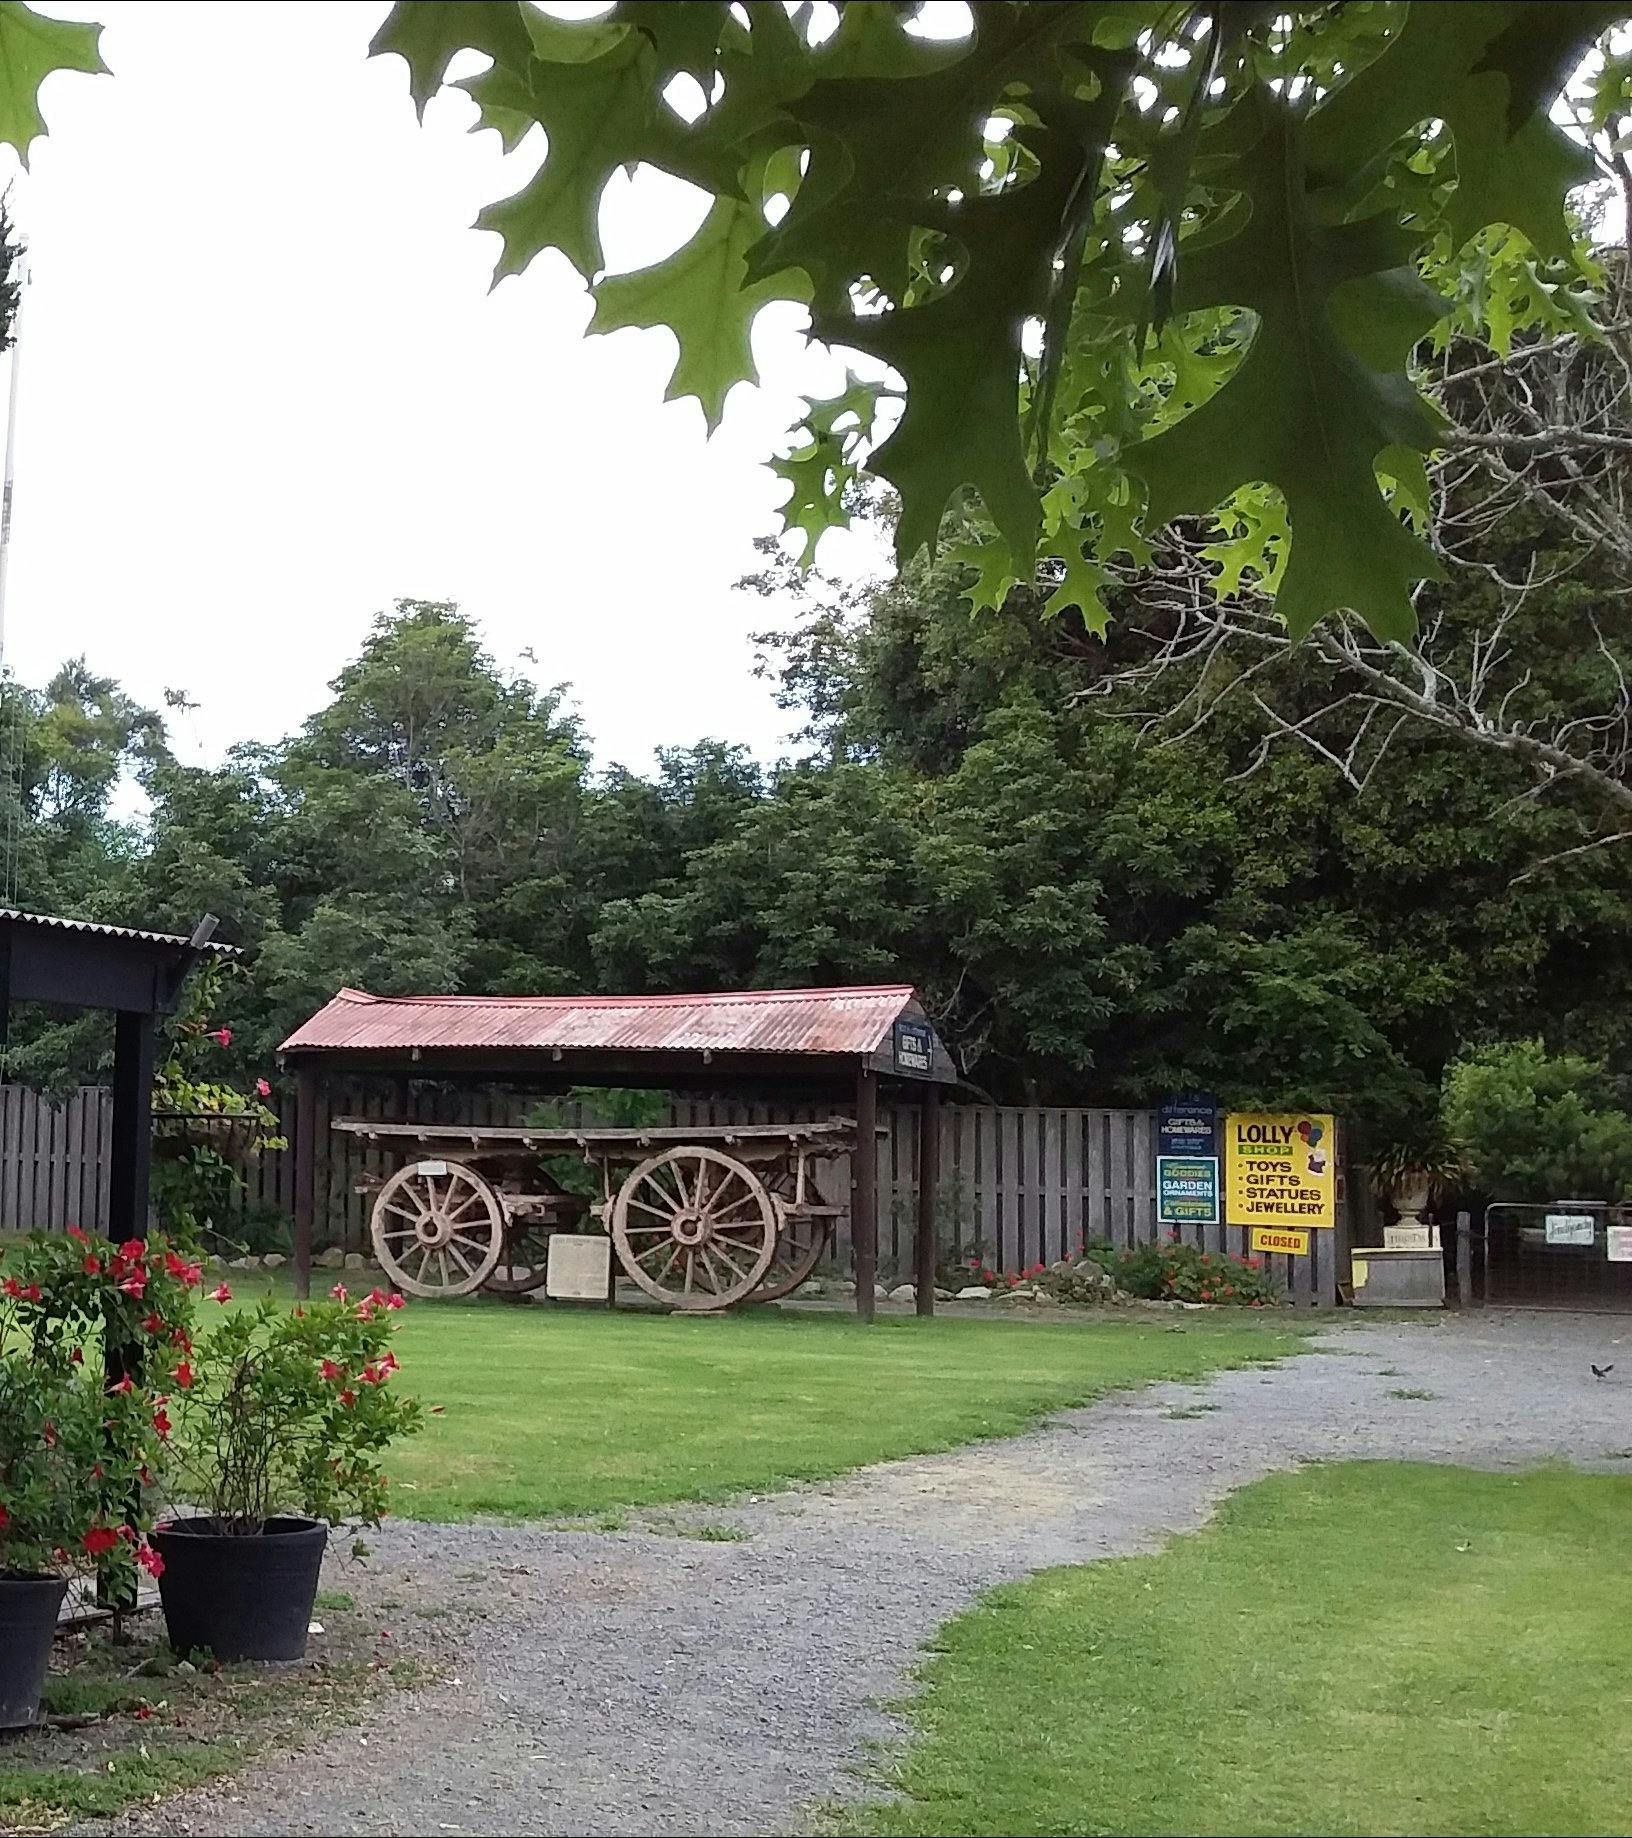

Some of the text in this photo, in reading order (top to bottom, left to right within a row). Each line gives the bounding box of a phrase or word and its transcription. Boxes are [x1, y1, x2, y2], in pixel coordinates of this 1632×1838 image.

[1237, 1124, 1295, 1144] LOLLY
[1241, 1145, 1291, 1155] SHOP
[1246, 1160, 1292, 1173] TOYS
[1162, 1180, 1213, 1190] GARDEN
[1246, 1174, 1301, 1187] GIFTS
[1246, 1187, 1322, 1201] STATUES
[1163, 1206, 1212, 1217] & GIFTS
[1246, 1201, 1325, 1215] JEWELLERY
[1260, 1234, 1301, 1249] CLOSED
